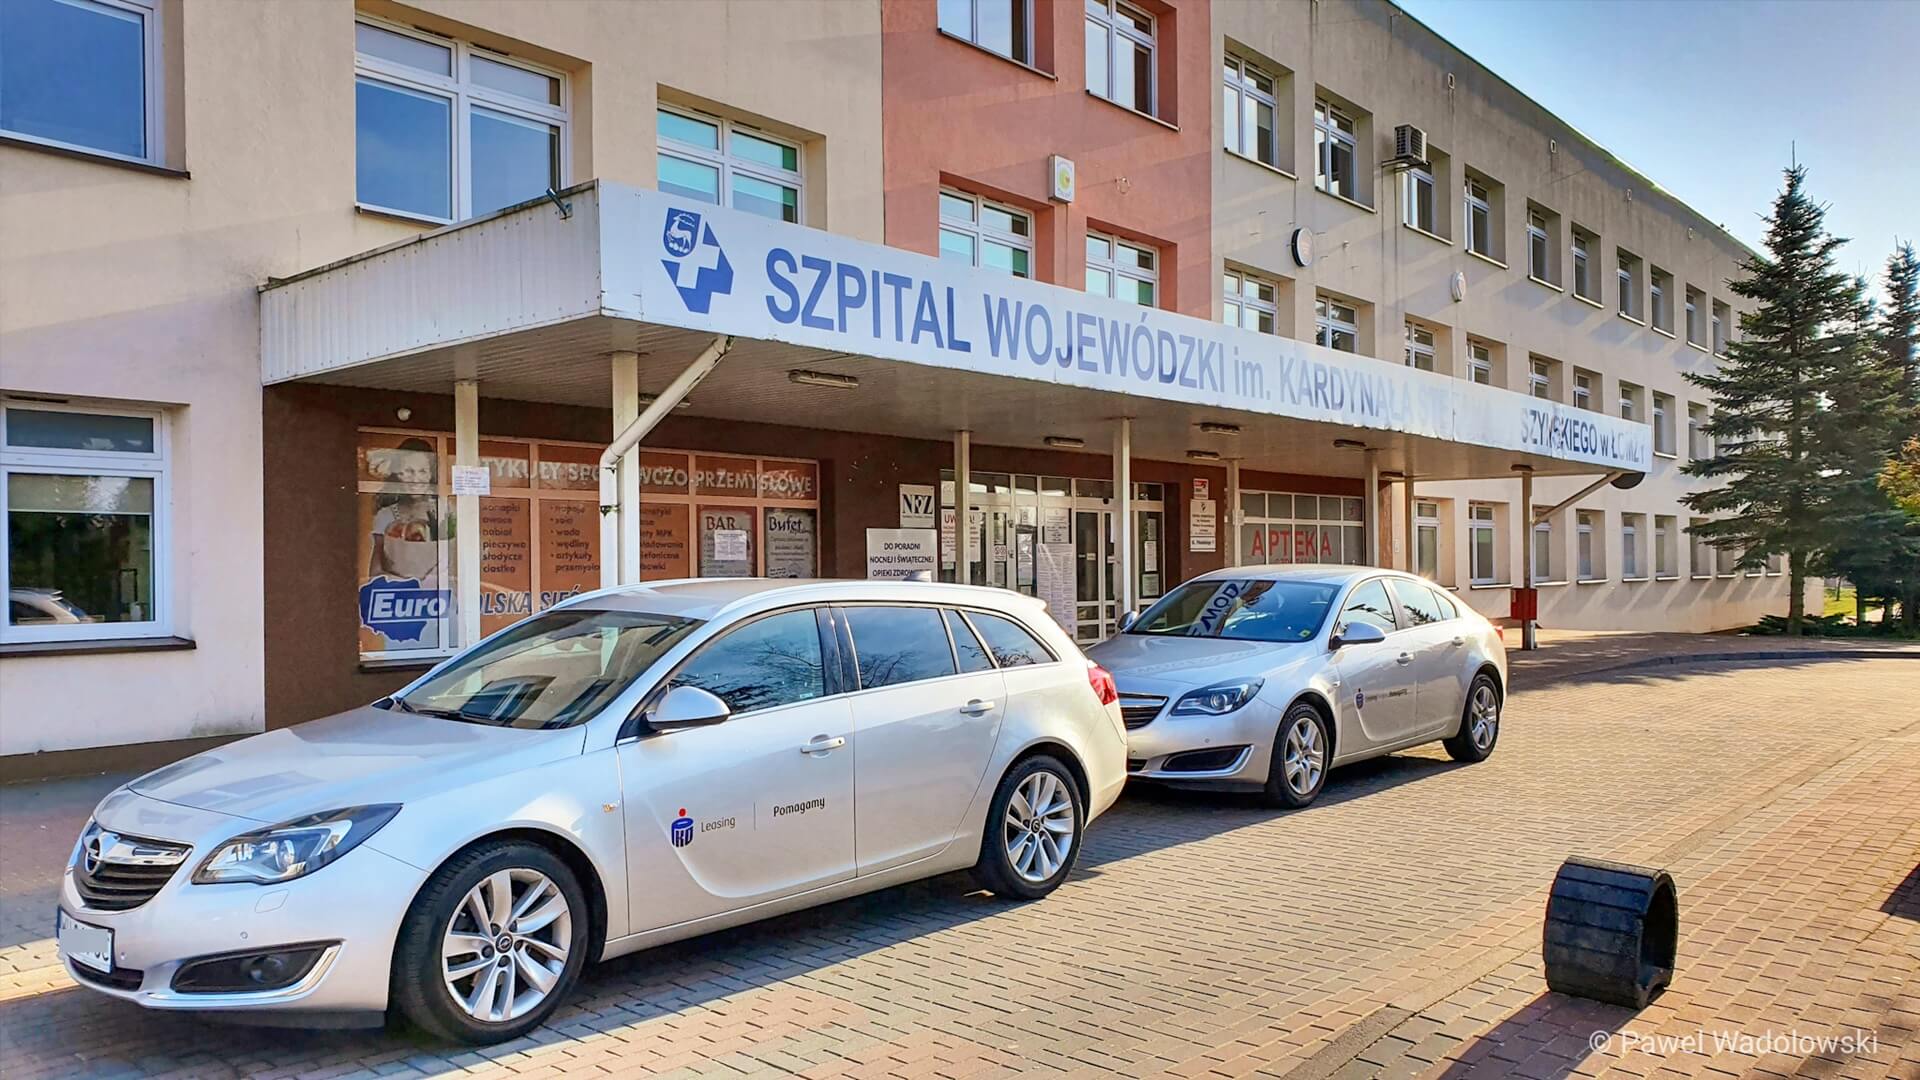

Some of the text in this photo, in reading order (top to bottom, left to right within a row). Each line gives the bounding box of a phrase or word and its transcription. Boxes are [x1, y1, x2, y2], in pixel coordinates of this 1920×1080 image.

[766, 248, 971, 352] SZPITAL
[983, 294, 1225, 392] WOJEWÓDZKI
[1234, 346, 1270, 400] im.
[1600, 433, 1609, 457] w
[705, 516, 736, 530] BAR
[769, 514, 802, 531] Bufet
[884, 542, 921, 551] DO PORADNI
[1251, 528, 1332, 557] APTEKA
[555, 562, 600, 574] przemysło
[872, 569, 892, 577] OPIEKI
[372, 593, 448, 618] Euro
[701, 816, 736, 833] Leasing
[773, 797, 826, 817] Pomagamy
